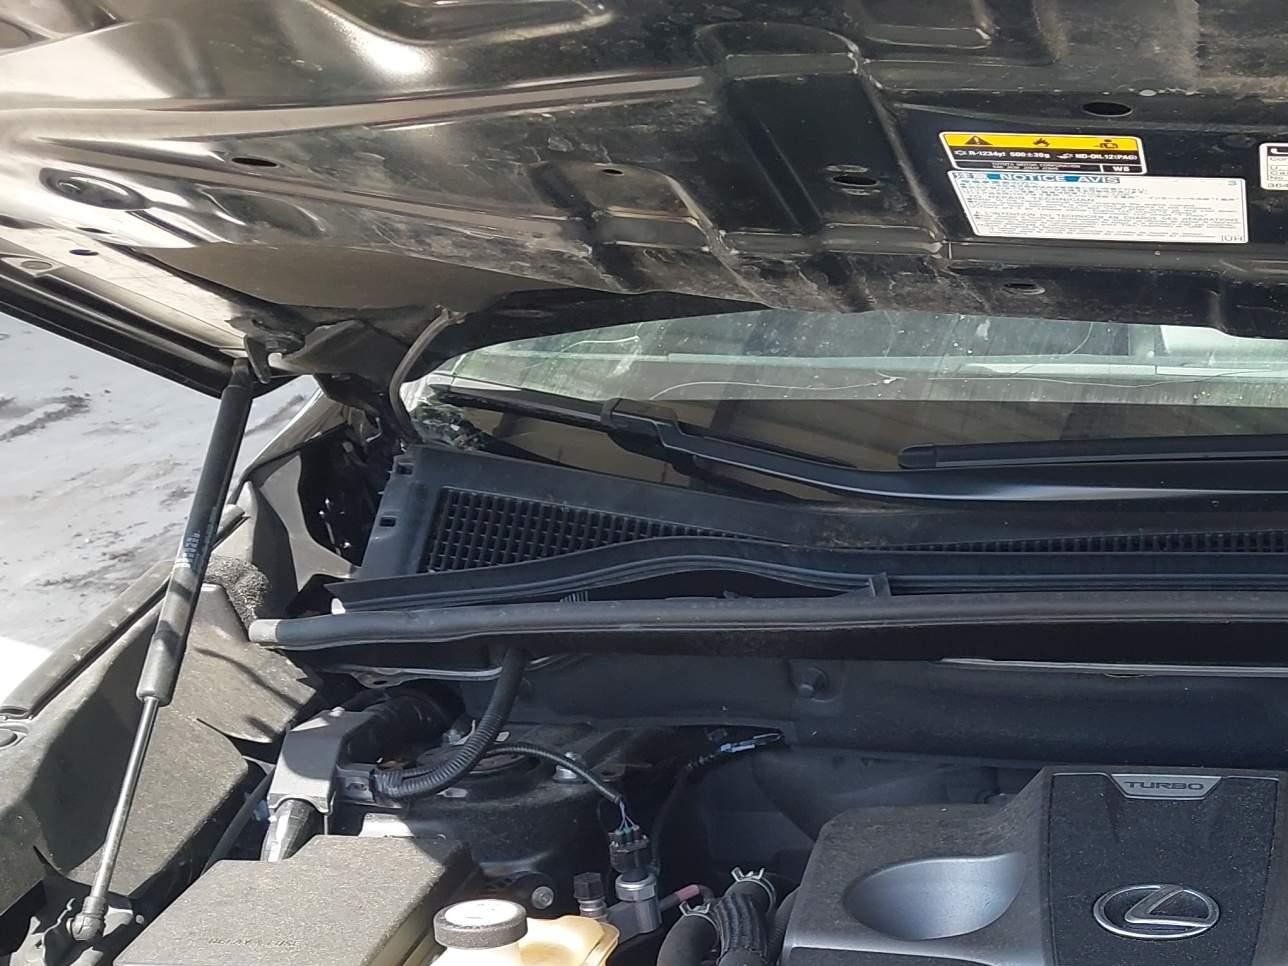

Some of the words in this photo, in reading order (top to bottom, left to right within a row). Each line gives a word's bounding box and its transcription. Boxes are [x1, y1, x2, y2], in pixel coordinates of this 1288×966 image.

[1000, 173, 1065, 181] NOTICE
[1080, 176, 1120, 184] AVIS
[1123, 781, 1205, 791] TURBO
